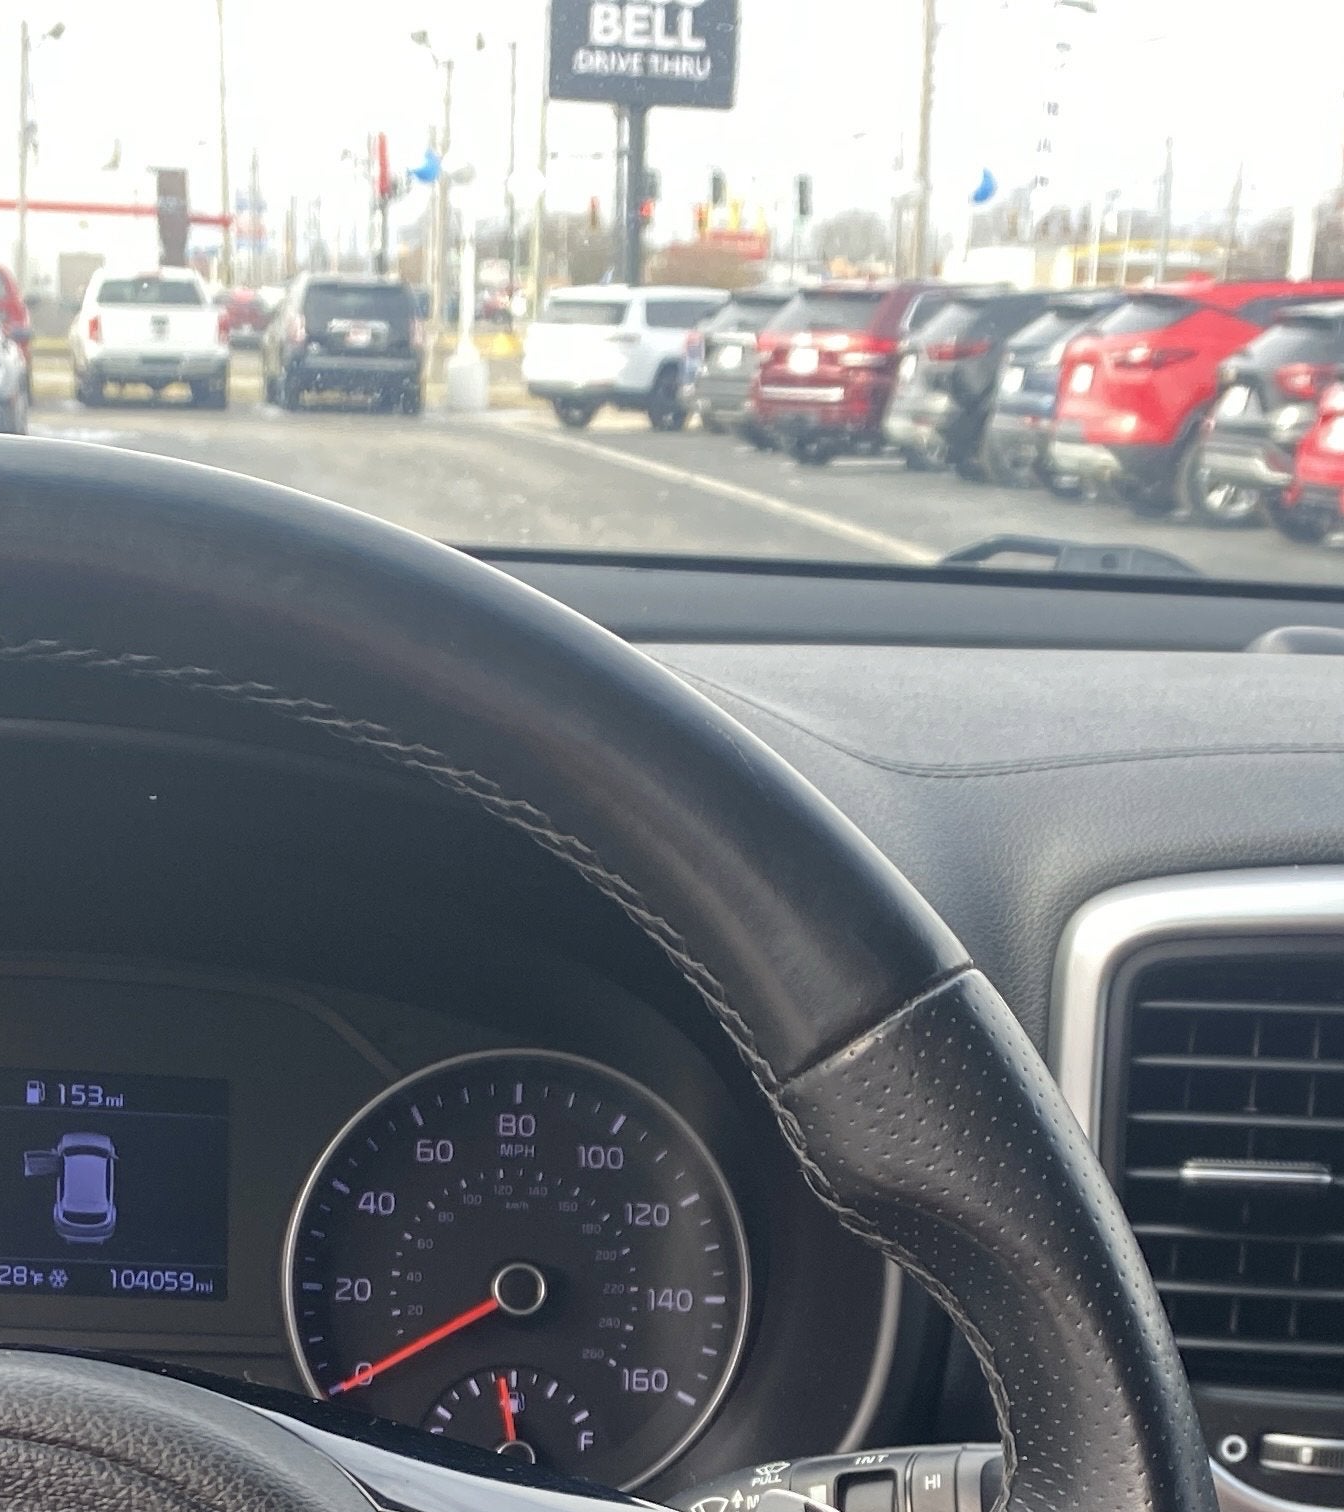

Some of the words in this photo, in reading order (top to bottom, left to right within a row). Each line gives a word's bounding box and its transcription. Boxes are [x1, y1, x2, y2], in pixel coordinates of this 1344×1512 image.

[590, 2, 706, 50] BELL
[572, 49, 644, 76] DRIVE
[647, 53, 712, 81] THRU
[498, 1113, 536, 1138] 80
[416, 1139, 453, 1163] 60
[499, 1143, 535, 1159] MPH
[578, 1146, 624, 1170] 100
[463, 1194, 483, 1205] 100
[493, 1184, 514, 1196] 120
[528, 1186, 548, 1197] 140
[358, 1192, 395, 1216] 40
[625, 1203, 670, 1228] 120
[595, 1250, 617, 1262] 200
[406, 1272, 423, 1283] 40
[334, 1278, 372, 1302] 20
[603, 1284, 625, 1295] 220
[647, 1288, 693, 1312] 140
[407, 1305, 424, 1316] 20
[598, 1318, 621, 1329] 240
[355, 1361, 375, 1387] 0
[622, 1368, 669, 1393] 160
[578, 1430, 595, 1452] F
[855, 1454, 889, 1466] INT
[751, 1473, 783, 1487] PULL
[923, 1473, 942, 1490] HI
